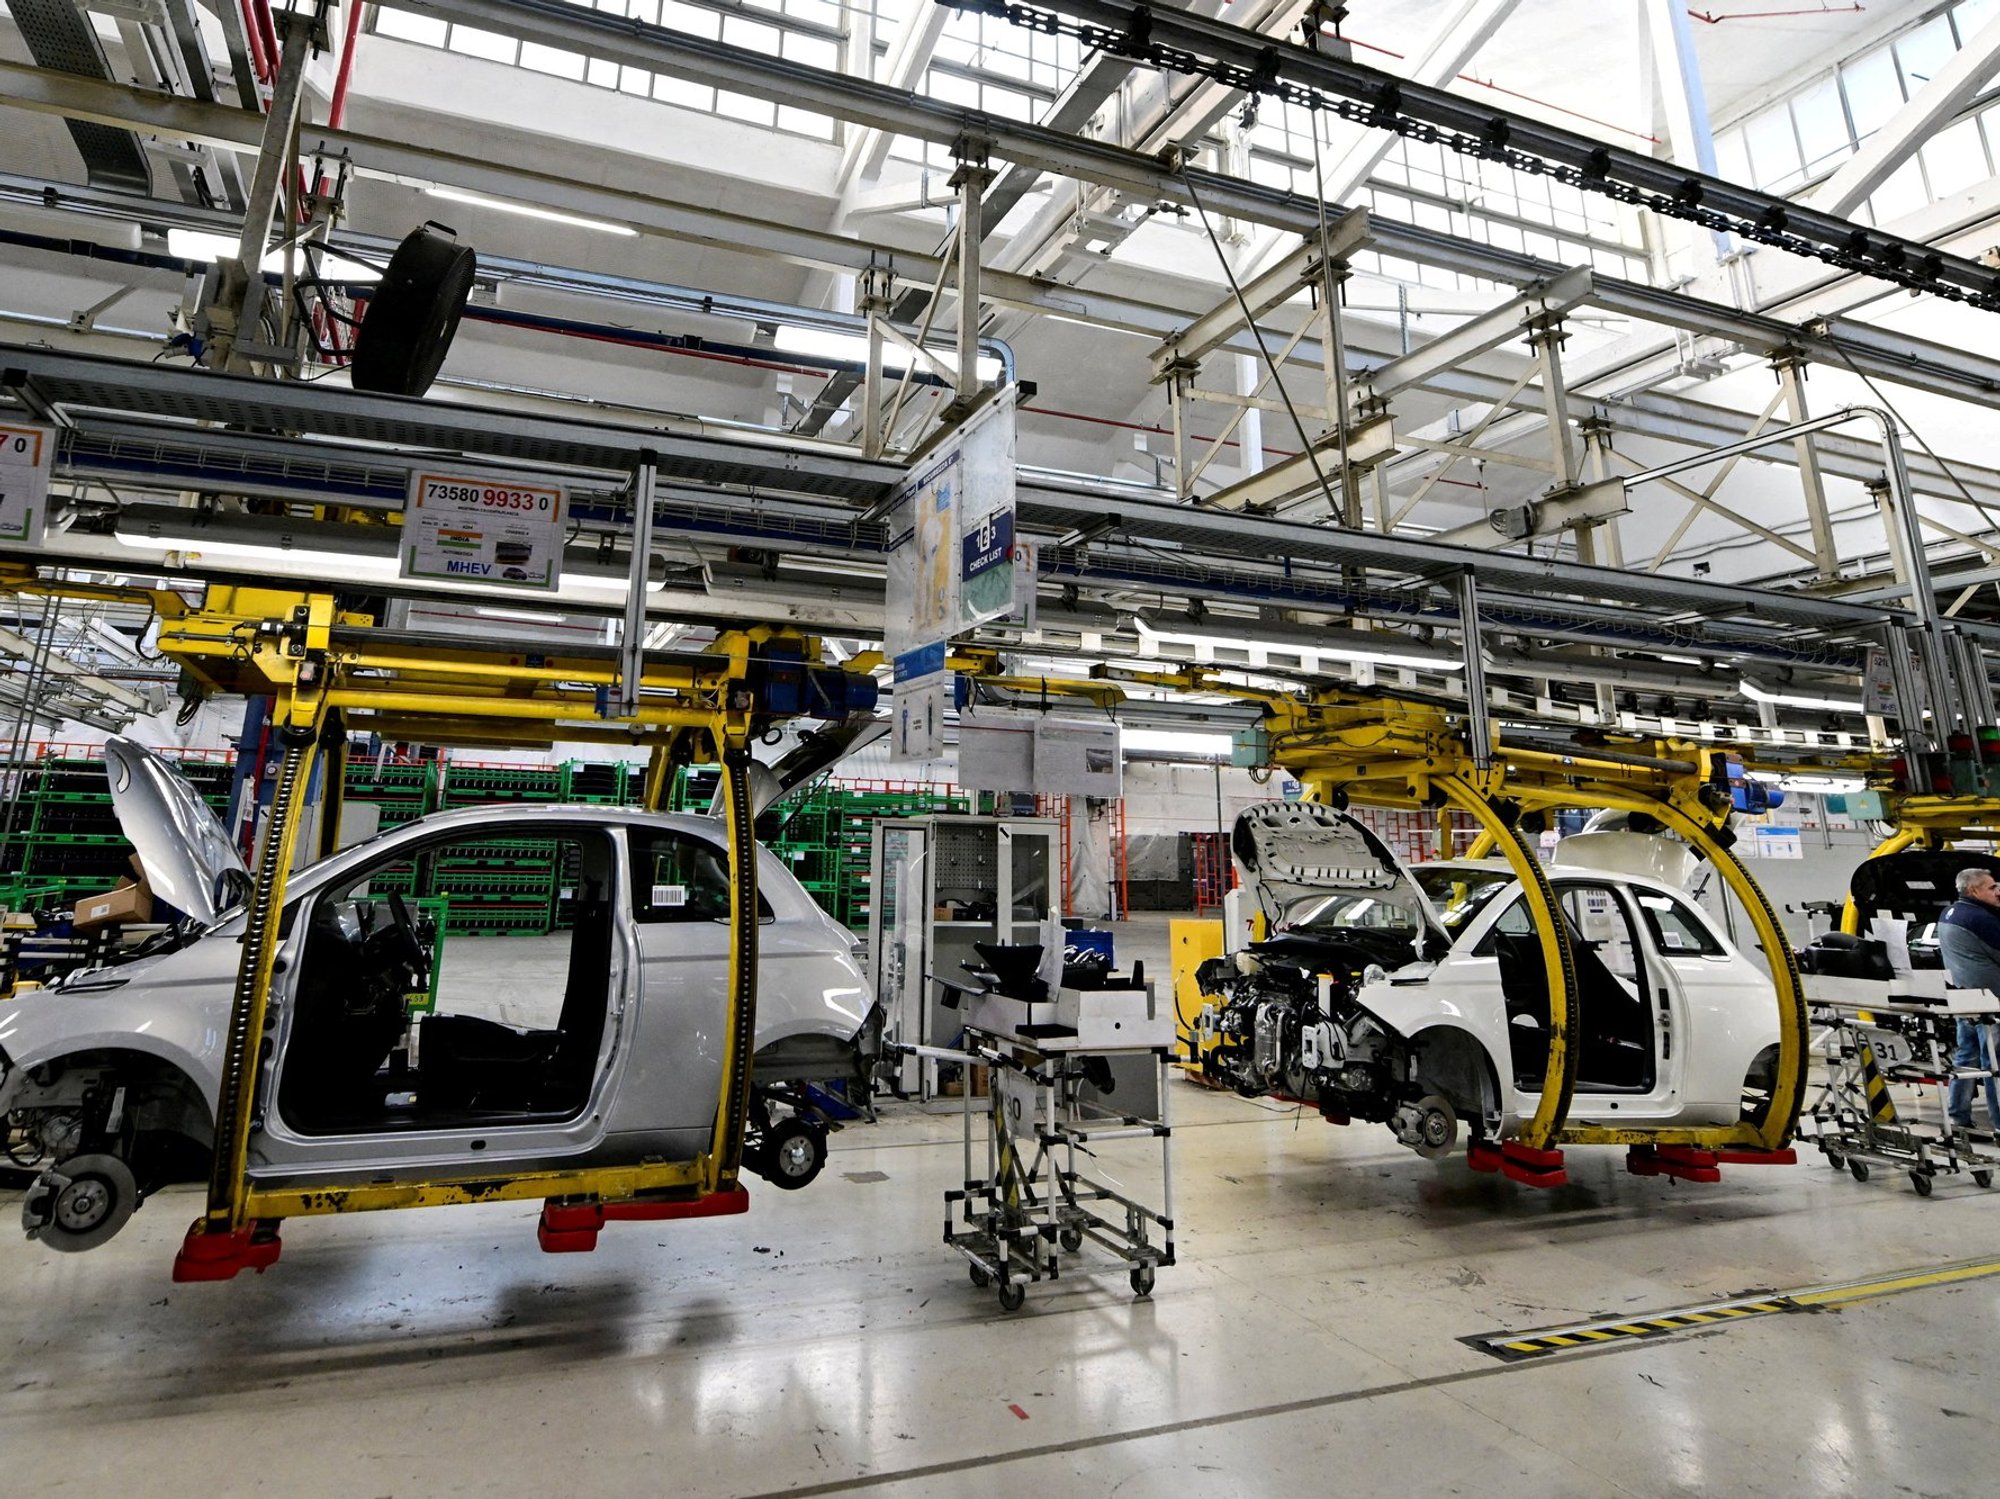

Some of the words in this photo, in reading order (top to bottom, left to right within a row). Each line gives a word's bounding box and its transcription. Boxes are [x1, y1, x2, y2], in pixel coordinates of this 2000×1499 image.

[14, 437, 27, 453] 0
[428, 483, 479, 503] 73580
[483, 488, 534, 511] 9933
[538, 497, 549, 511] 0
[447, 560, 492, 576] MHEV
[969, 553, 989, 572] CHECK
[989, 547, 1003, 562] LIST
[1874, 1041, 1899, 1062] 31
[1006, 1093, 1021, 1121] 30
